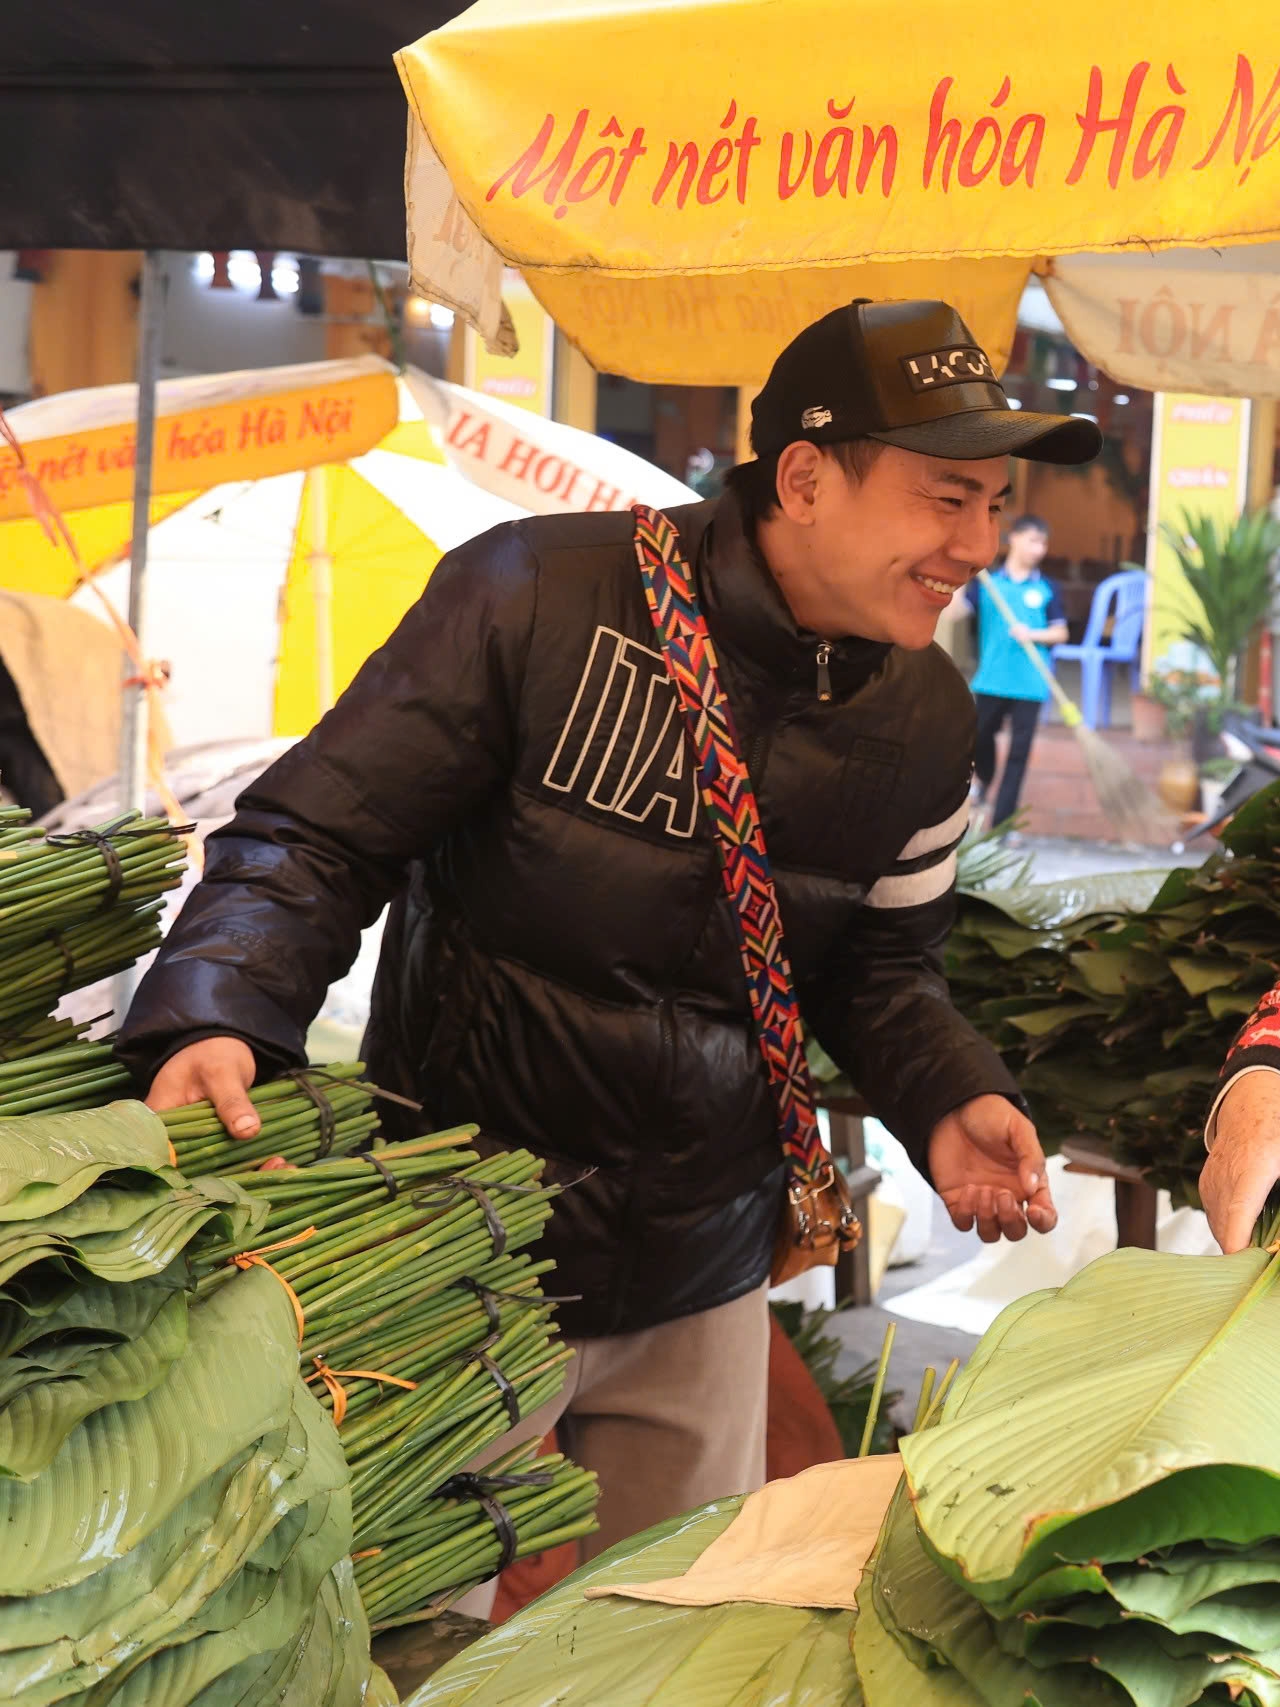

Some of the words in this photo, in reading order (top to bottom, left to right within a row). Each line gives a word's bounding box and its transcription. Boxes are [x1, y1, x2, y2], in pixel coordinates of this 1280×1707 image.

[485, 107, 648, 220] Một
[651, 99, 763, 210] nét
[777, 97, 900, 200] văn
[922, 75, 1047, 194] hóa
[1064, 61, 1187, 190] Hà
[166, 418, 226, 462] hóa
[236, 406, 288, 452] Hà
[296, 398, 355, 444] Nội
[446, 411, 493, 462] IA
